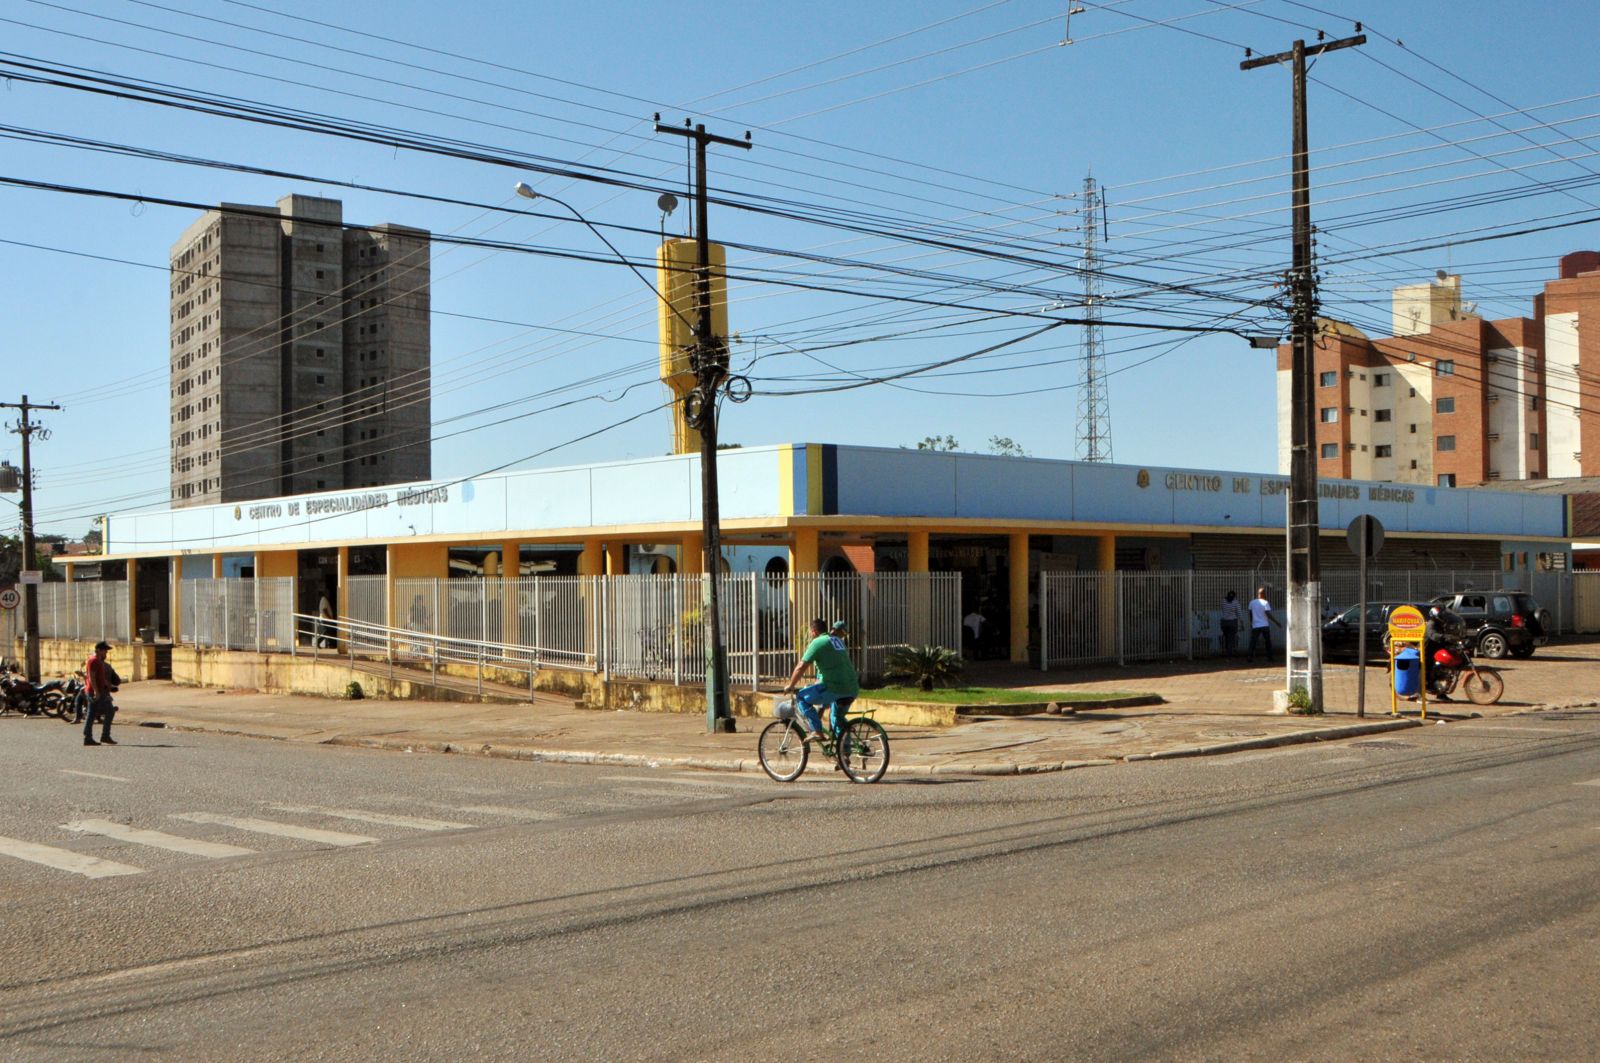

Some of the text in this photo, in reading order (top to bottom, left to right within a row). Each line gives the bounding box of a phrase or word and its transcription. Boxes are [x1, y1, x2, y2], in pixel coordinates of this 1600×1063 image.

[249, 486, 449, 520] CENTRO DE ESPECIALIDADES MÉDICAS
[1165, 472, 1414, 503] CENTRO DE ESPIDADES MÉDICAS
[2, 592, 15, 602] 40
